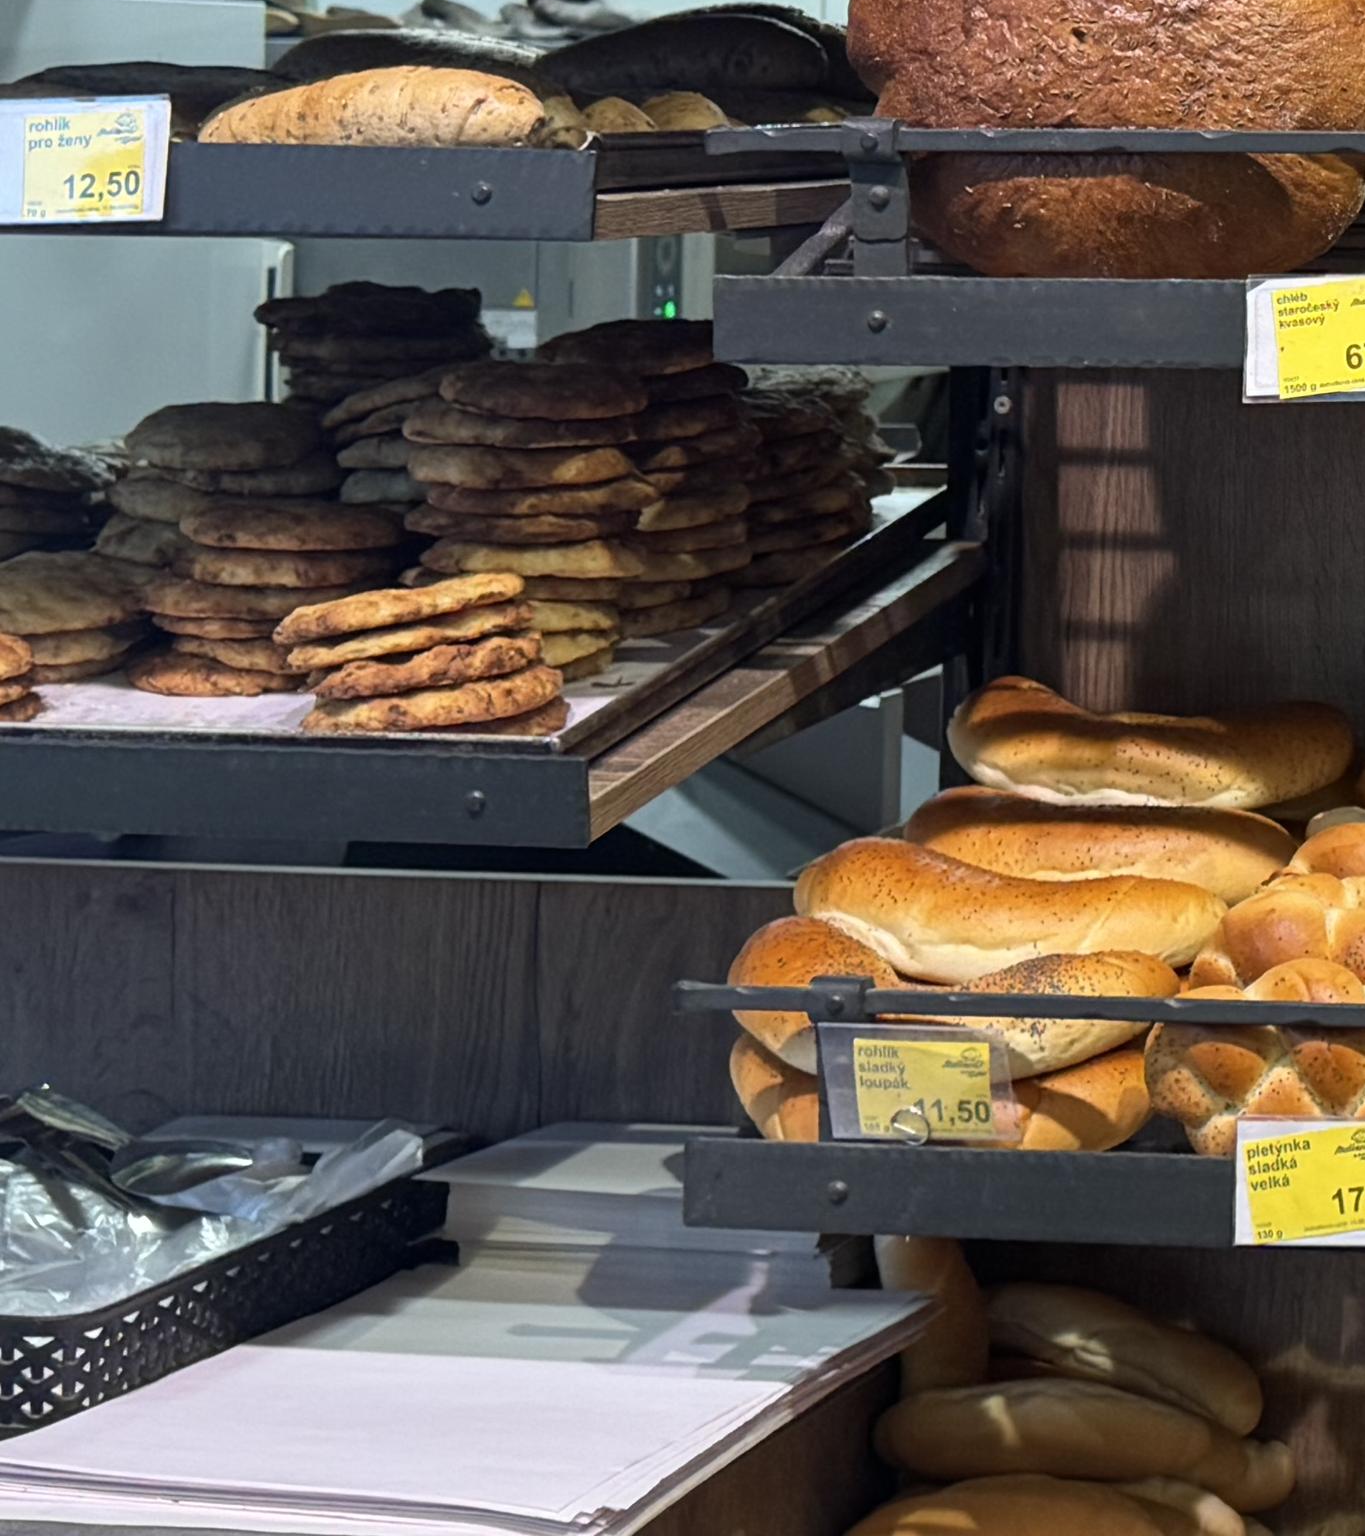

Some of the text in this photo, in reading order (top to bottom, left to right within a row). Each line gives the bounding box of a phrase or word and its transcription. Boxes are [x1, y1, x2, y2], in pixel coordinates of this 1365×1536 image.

[29, 117, 71, 133] rohlík
[28, 134, 92, 152] pro ženy
[63, 170, 142, 202] 12,50
[1276, 292, 1309, 306] chléb
[1278, 298, 1341, 317] staročeský
[1279, 313, 1326, 330] kvasový
[857, 1045, 900, 1057] rohlík
[858, 1061, 906, 1076] sladký
[859, 1075, 909, 1090] loupák
[913, 1097, 991, 1127] 11,50
[1246, 1138, 1312, 1161] pletýnka
[1248, 1157, 1298, 1176] sladká
[1250, 1173, 1291, 1192] velká
